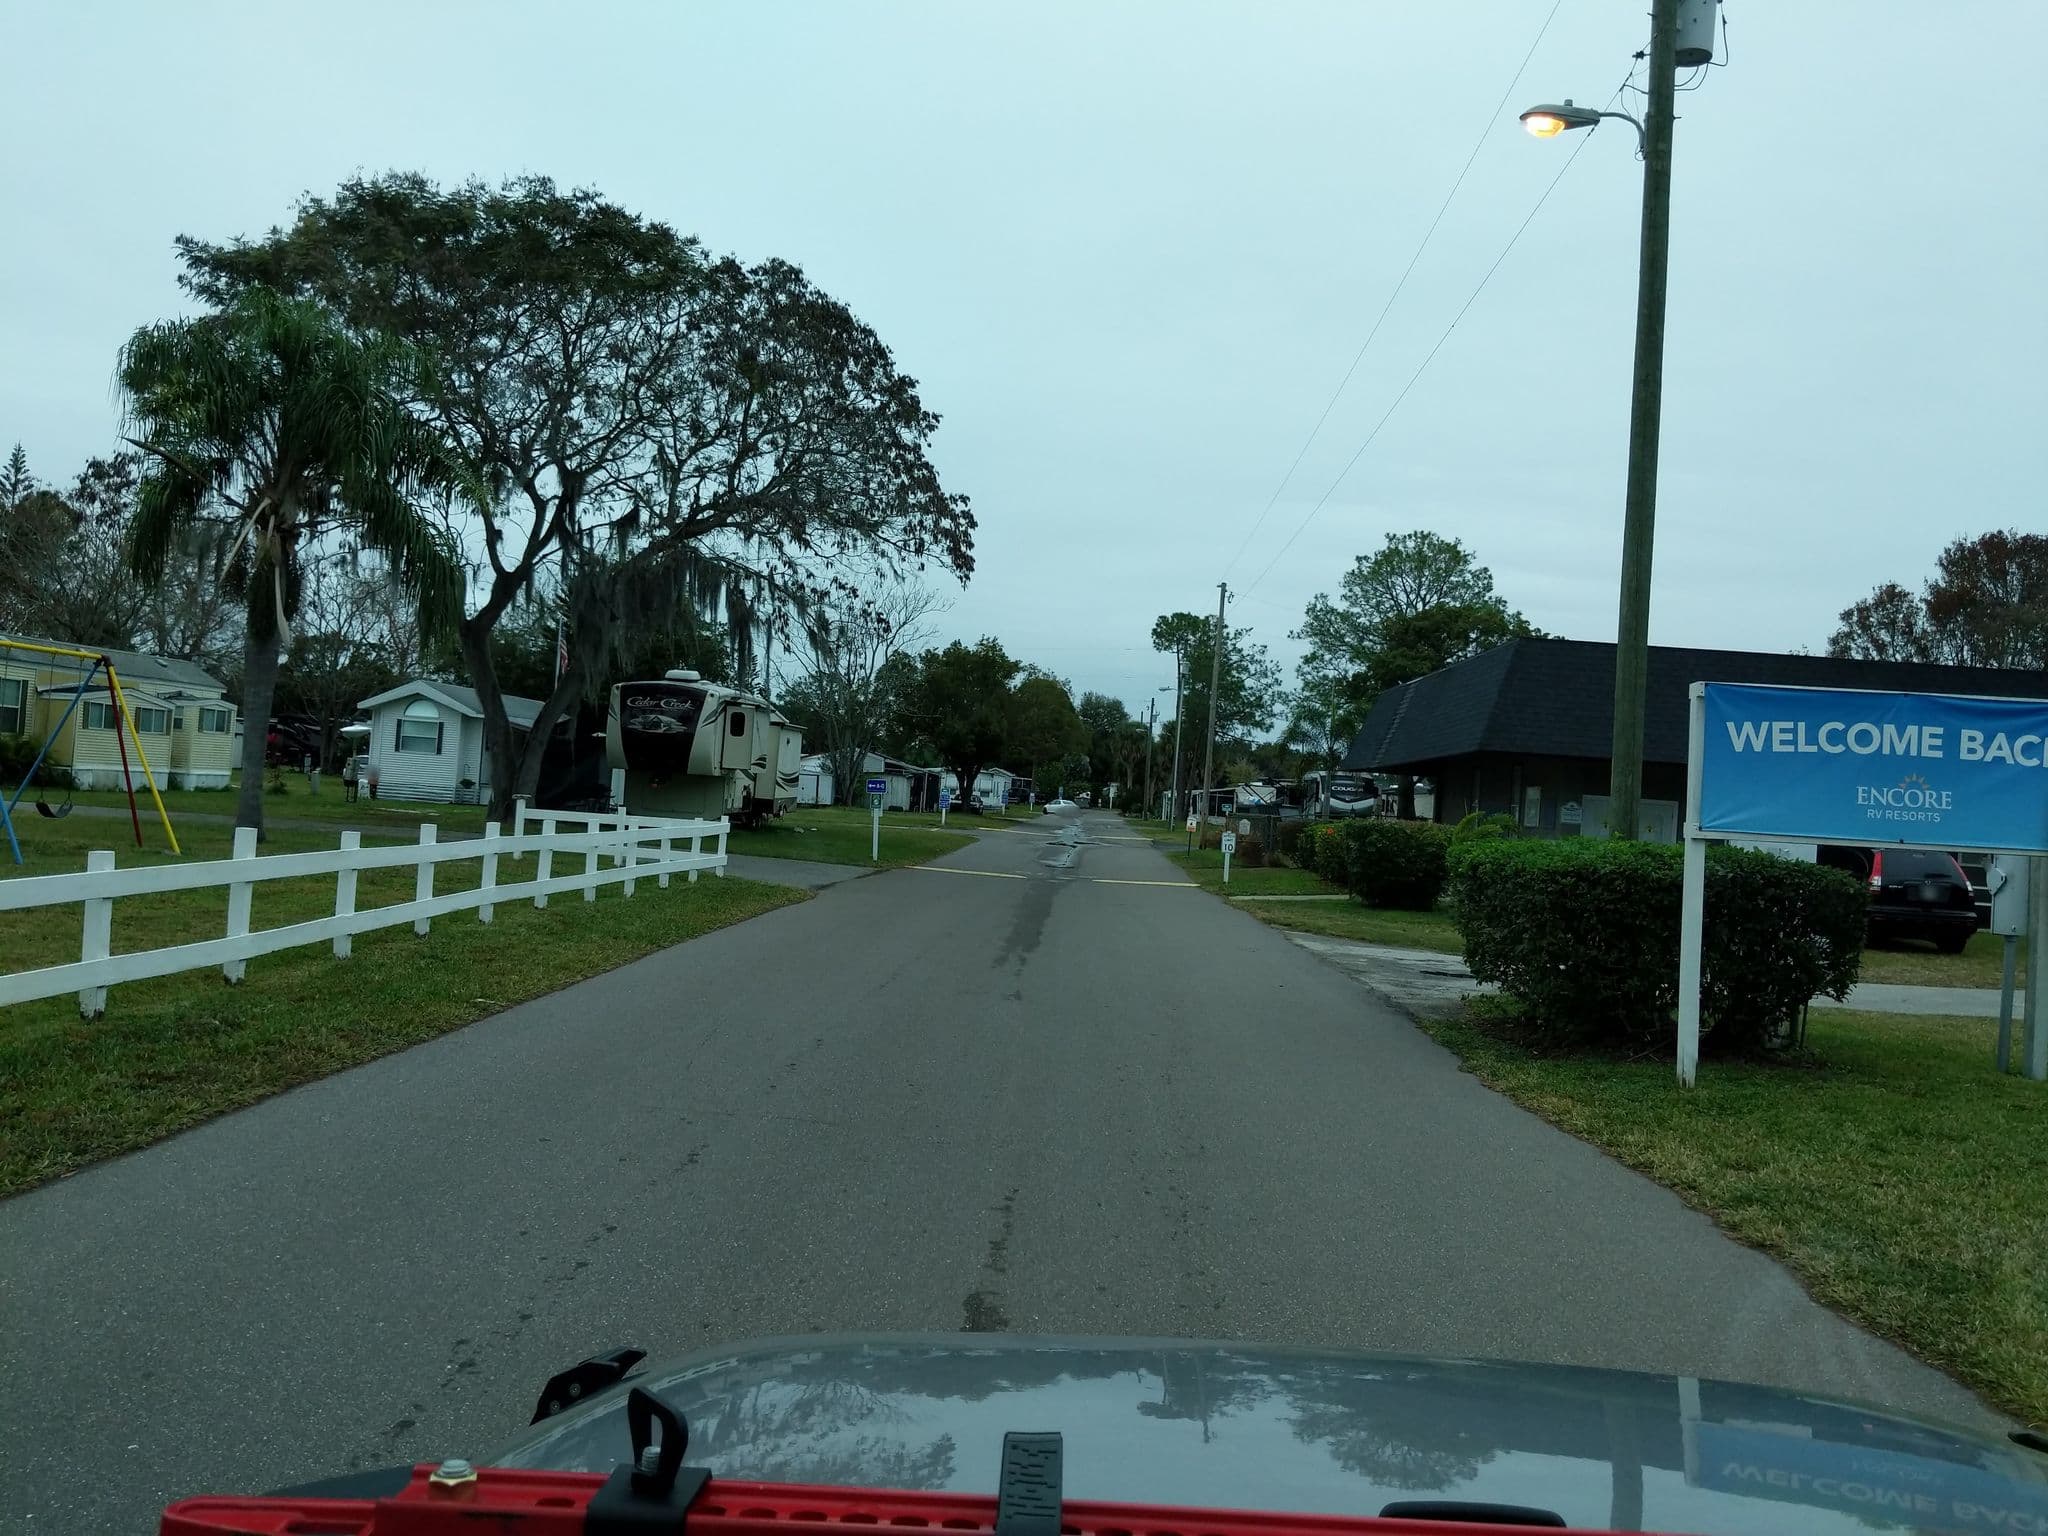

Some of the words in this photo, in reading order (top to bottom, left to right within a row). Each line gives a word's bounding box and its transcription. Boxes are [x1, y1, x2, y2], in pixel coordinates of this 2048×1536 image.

[1726, 721, 1944, 759] WELCOME
[1959, 729, 2048, 768] BAC
[1856, 786, 1952, 810] ENCORE
[1866, 809, 1882, 819] RV
[1885, 810, 1941, 822] RESORTS
[1224, 843, 1234, 852] 10
